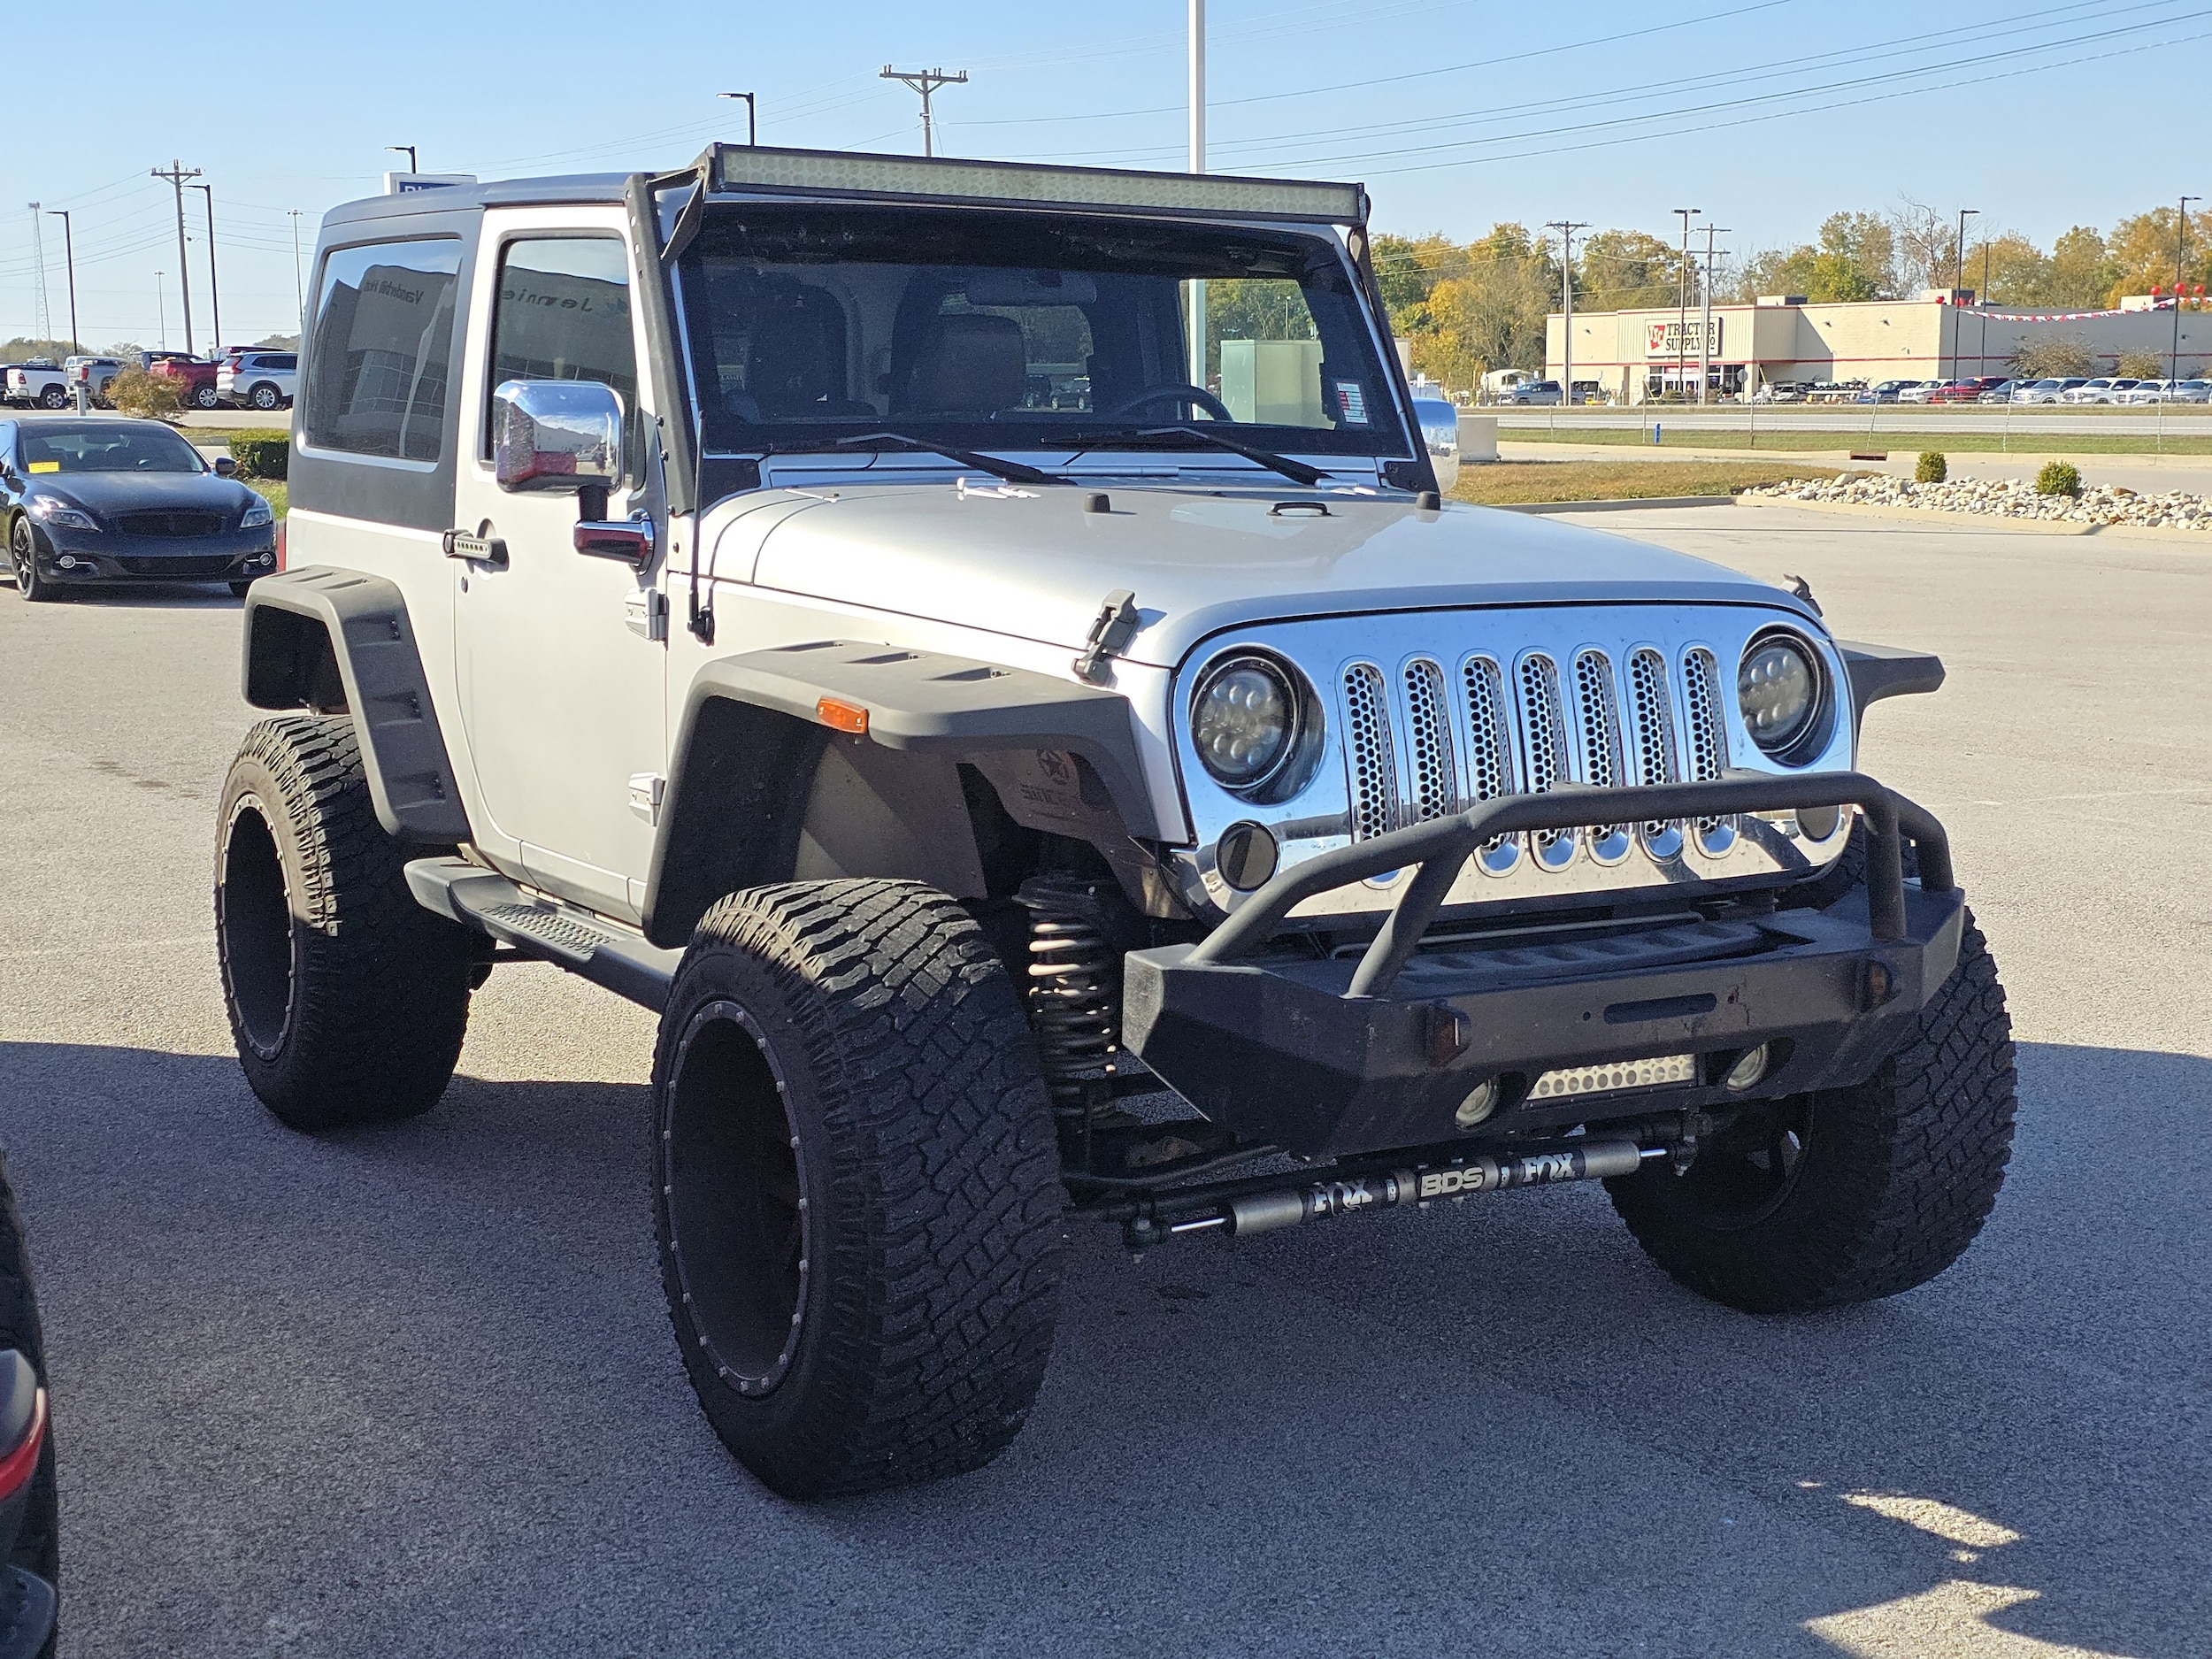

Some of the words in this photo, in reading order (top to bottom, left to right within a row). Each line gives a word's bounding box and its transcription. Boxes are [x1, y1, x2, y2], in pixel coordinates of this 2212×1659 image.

[1647, 325, 1663, 346] TSC
[1666, 322, 1715, 336] TRACTR
[1420, 1166, 1484, 1198] BDS
